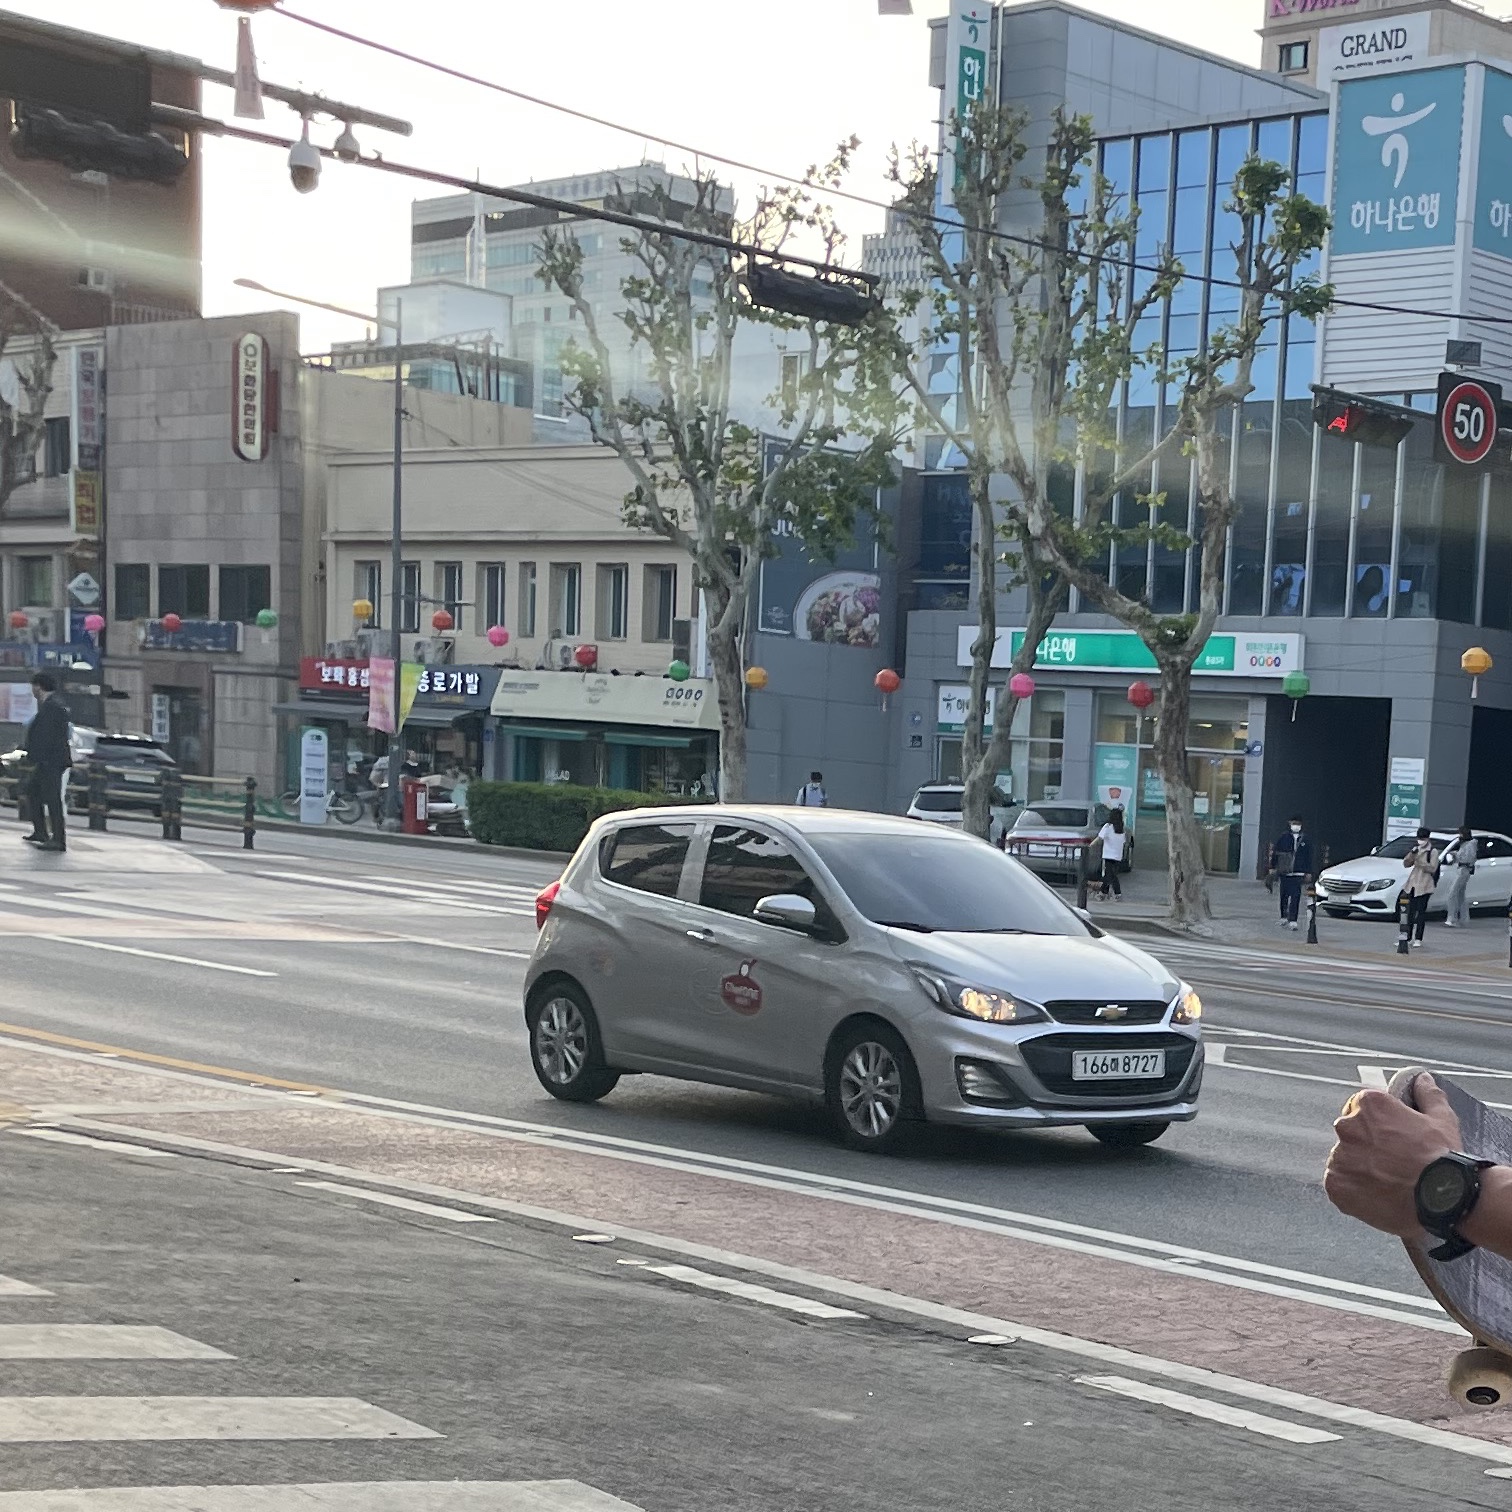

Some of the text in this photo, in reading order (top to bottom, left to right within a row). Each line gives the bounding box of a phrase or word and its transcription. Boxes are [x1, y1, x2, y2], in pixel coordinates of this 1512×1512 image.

[1341, 27, 1408, 58] GRAND
[1351, 192, 1441, 235] 하나은행
[1454, 403, 1484, 443] 50
